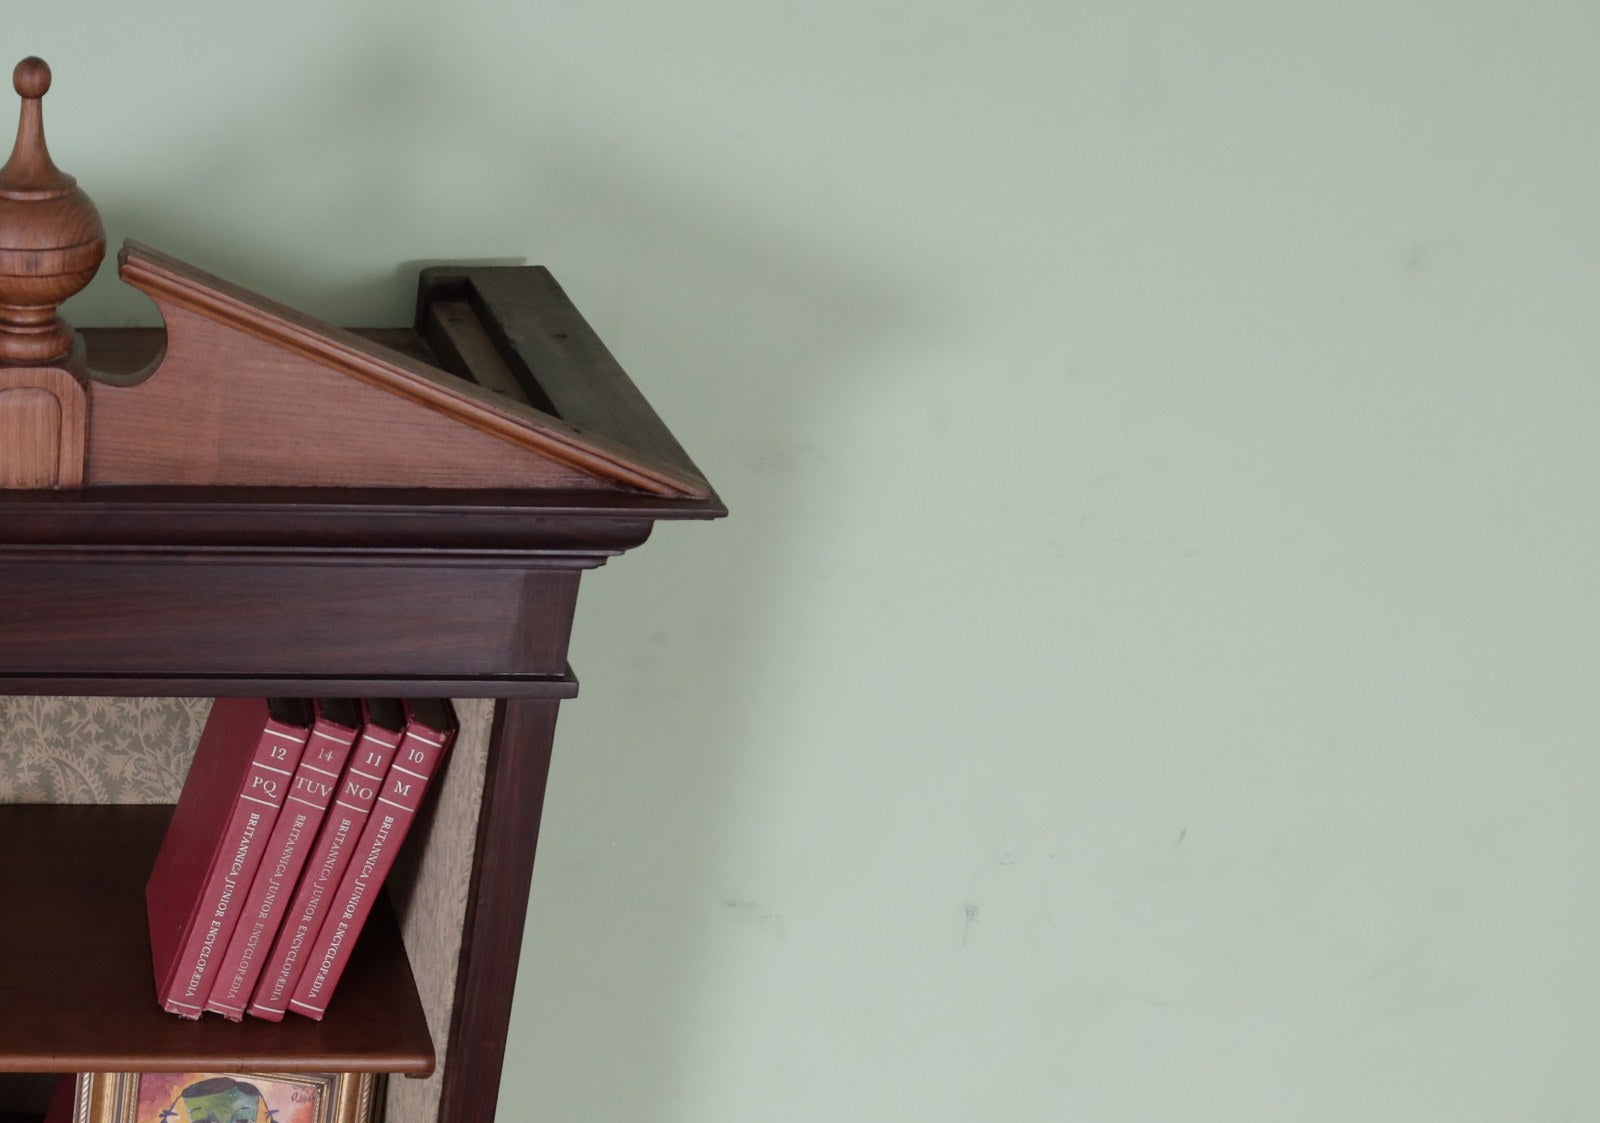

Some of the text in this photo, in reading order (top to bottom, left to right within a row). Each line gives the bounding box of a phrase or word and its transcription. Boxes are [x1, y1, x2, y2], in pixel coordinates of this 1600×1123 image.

[269, 745, 287, 761] 12
[317, 748, 334, 762] 14
[365, 752, 382, 767] 11
[407, 749, 425, 764] 10
[252, 776, 278, 799] PQ
[295, 776, 333, 797] TUV
[344, 781, 373, 800] NO
[393, 781, 411, 796] M
[229, 812, 260, 876] BRITANNICA
[274, 814, 306, 878] BRITANNICA
[318, 818, 351, 882] BRITANNICA
[360, 815, 394, 879] BRITANNICA
[215, 876, 237, 917] JUNIOR
[258, 878, 280, 919] JUNIOR
[302, 882, 325, 922] JUNIOR
[342, 878, 366, 920] JUNIOR
